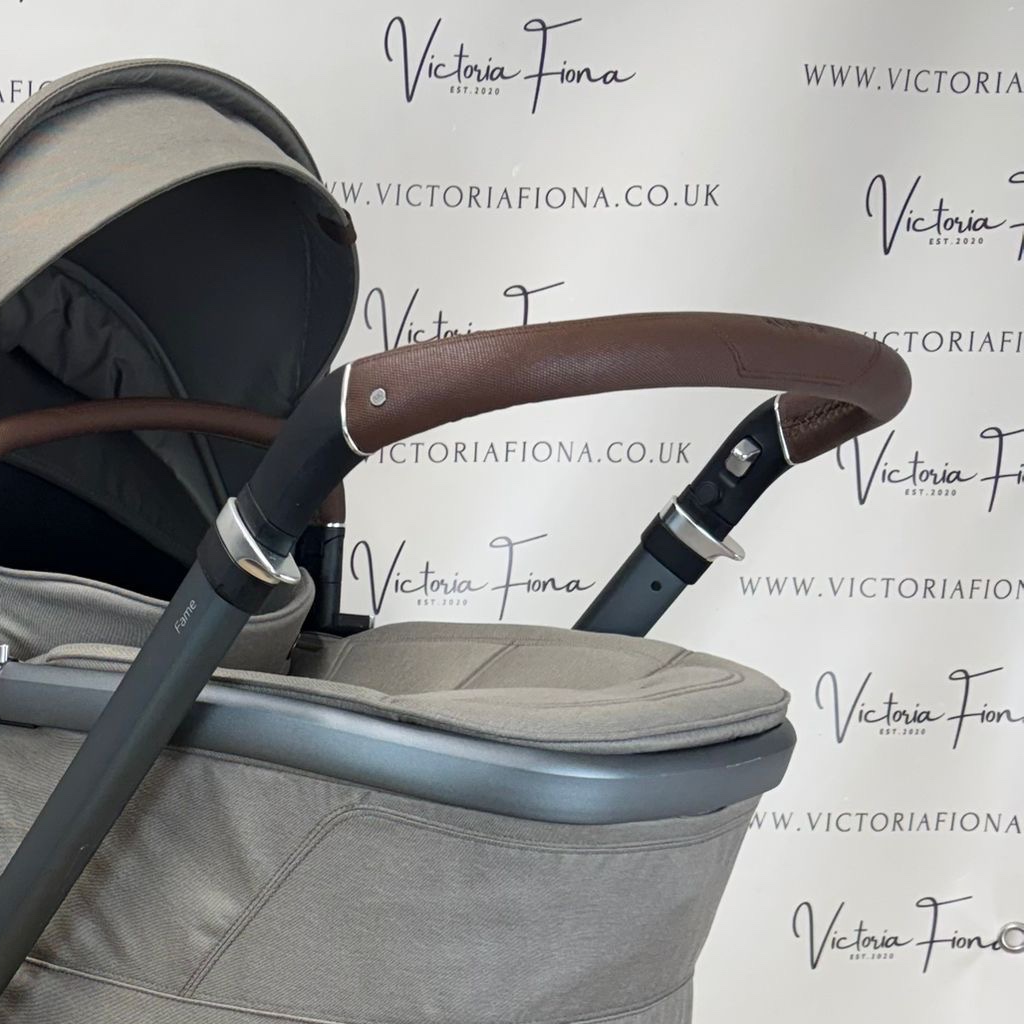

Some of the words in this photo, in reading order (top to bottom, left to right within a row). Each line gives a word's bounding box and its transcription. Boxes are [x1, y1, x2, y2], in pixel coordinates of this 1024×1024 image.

[384, 16, 521, 103] Victoria
[523, 18, 636, 115] Fiona
[450, 85, 500, 96] EST.2020
[865, 174, 1007, 256] Victoria
[929, 237, 984, 246] EST.2020
[365, 441, 692, 464] ICTORIAFIONA.CO.UK
[837, 430, 977, 505] Victoria
[905, 488, 957, 496] EST.2020
[350, 540, 488, 615] Victoria
[489, 533, 596, 621] Fiona
[174, 600, 197, 634] Fame
[815, 671, 946, 744] Victoria
[792, 901, 914, 970] Victoria
